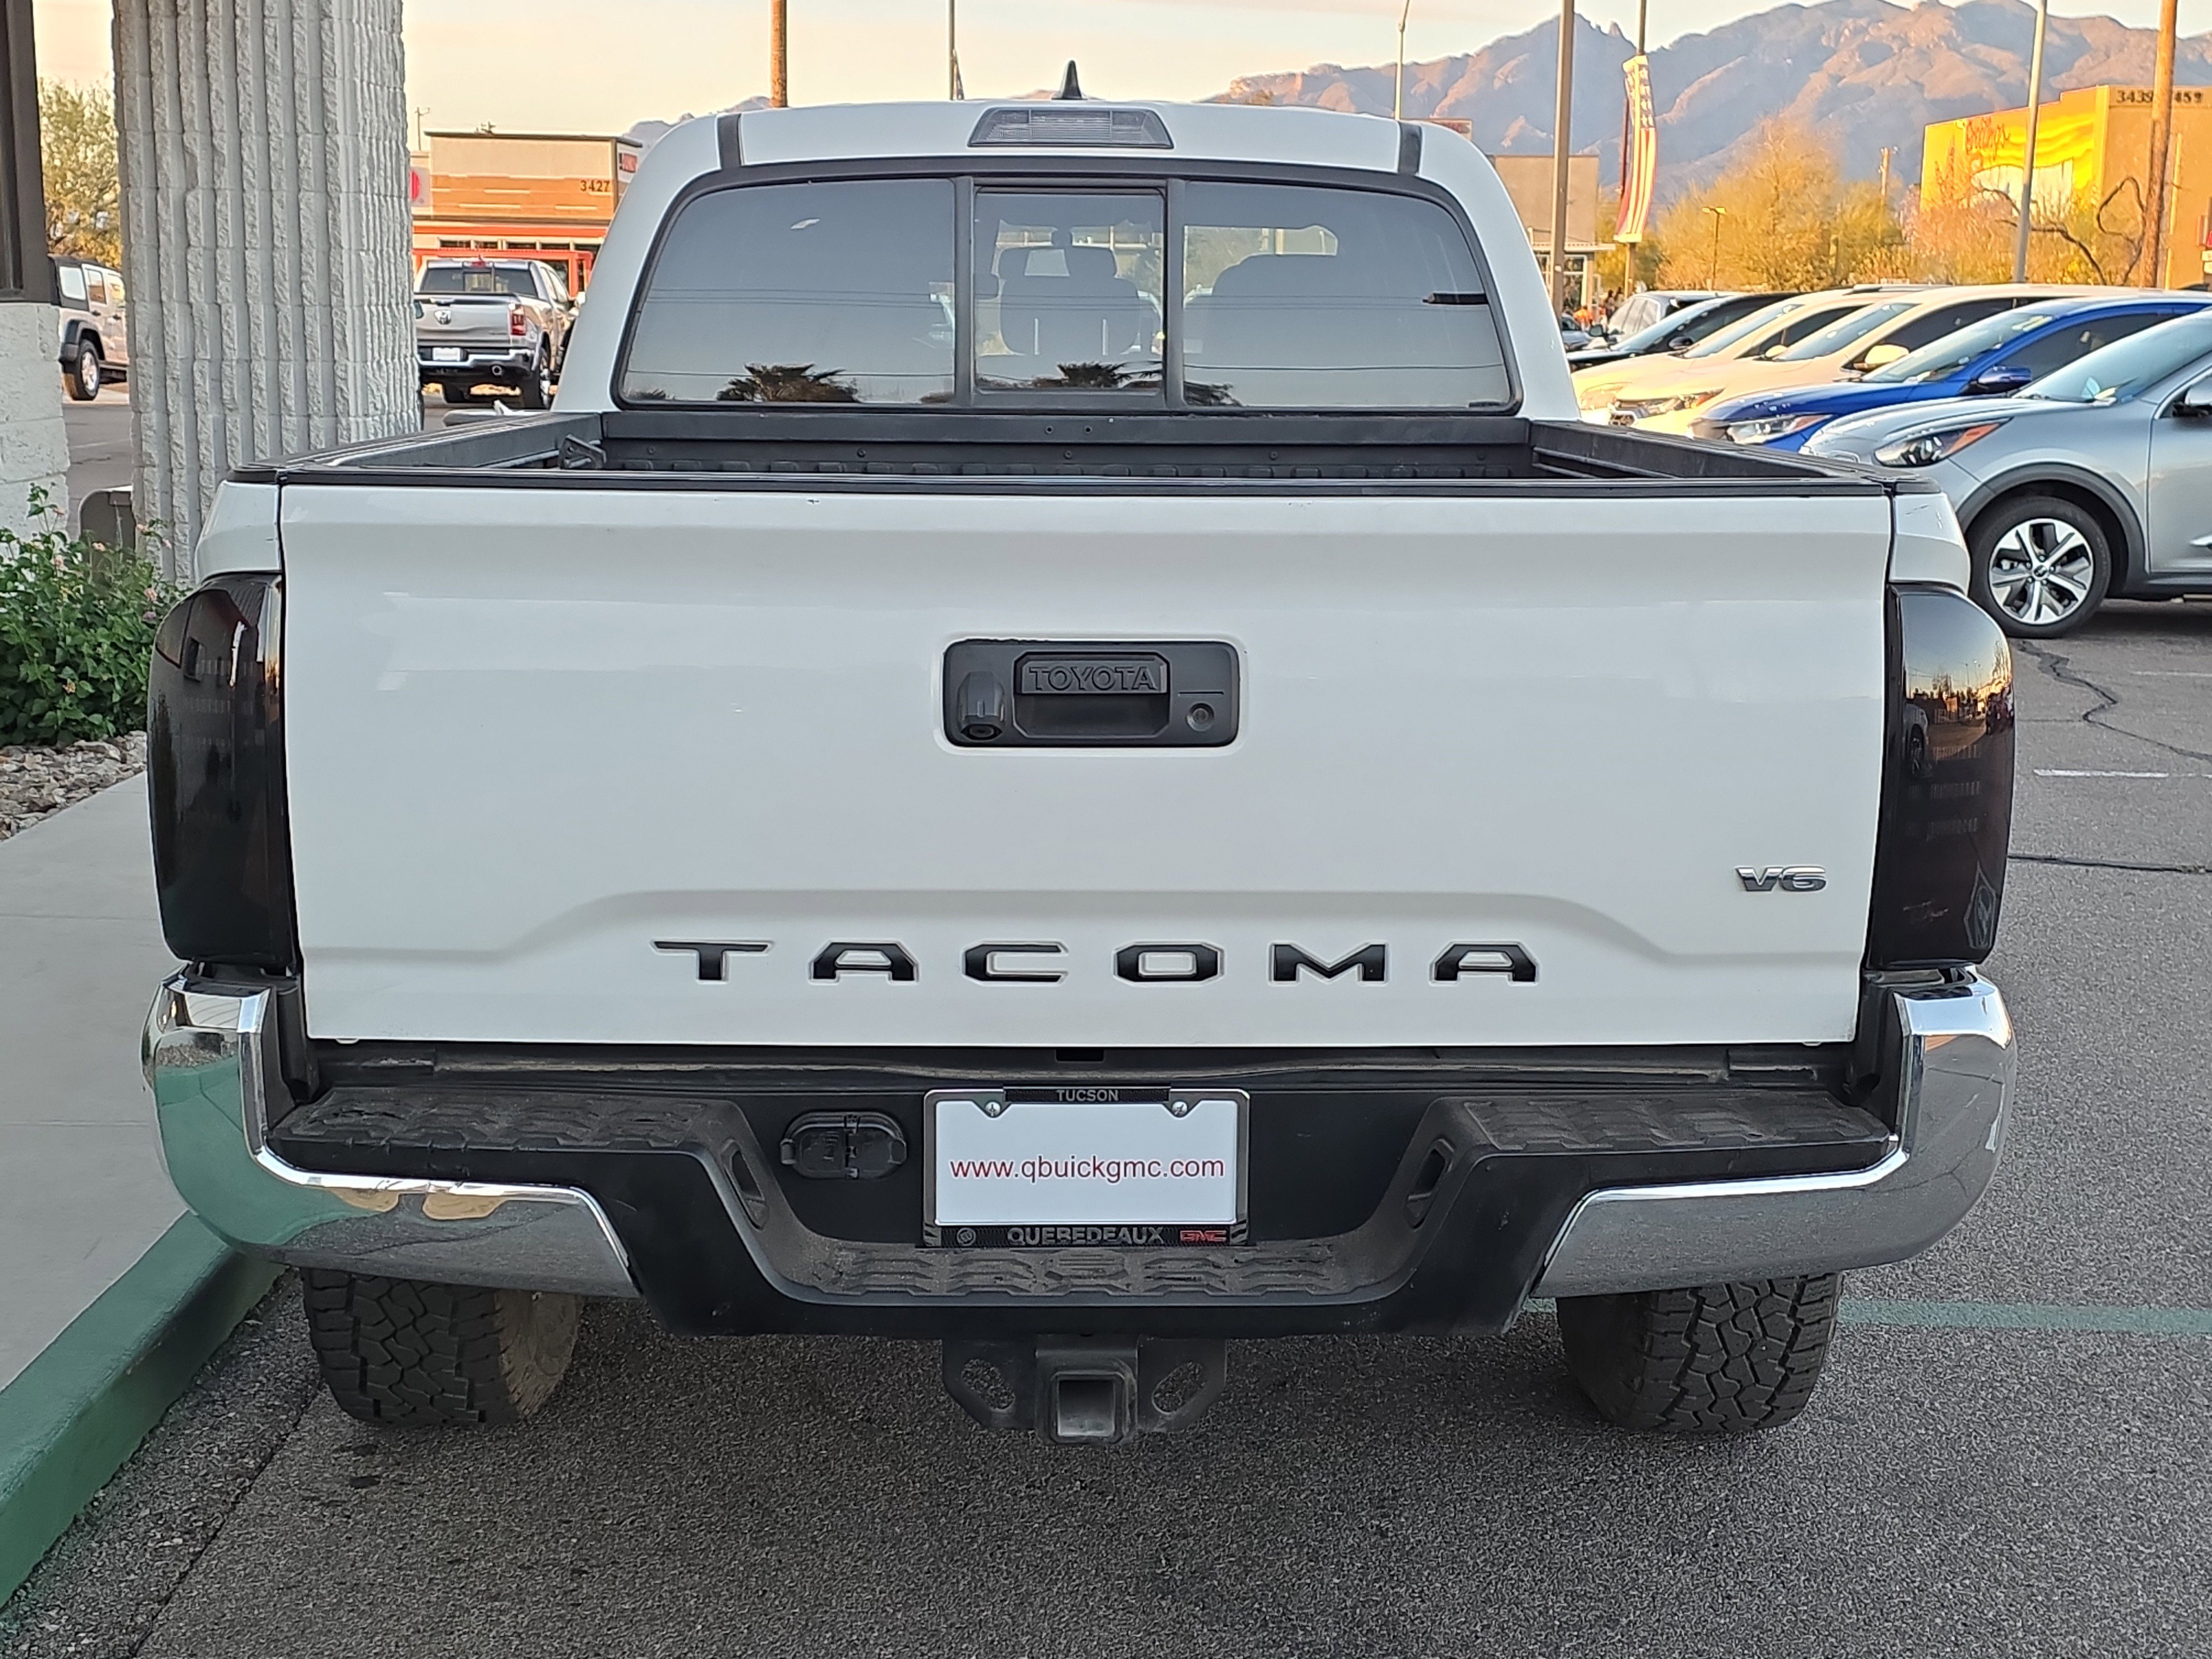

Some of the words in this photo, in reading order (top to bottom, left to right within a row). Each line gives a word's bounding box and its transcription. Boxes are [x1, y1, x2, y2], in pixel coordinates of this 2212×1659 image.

[580, 179, 610, 192] 3427
[1029, 665, 1157, 691] TOYOTA
[1735, 866, 1827, 892] V6
[653, 940, 1540, 983] TACOMA
[1056, 1089, 1118, 1102] TUCSON
[949, 1155, 1225, 1184] www.qbuickgmc.com
[1007, 1226, 1165, 1245] QUEBEDEAUX
[1179, 1230, 1227, 1242] GMC
